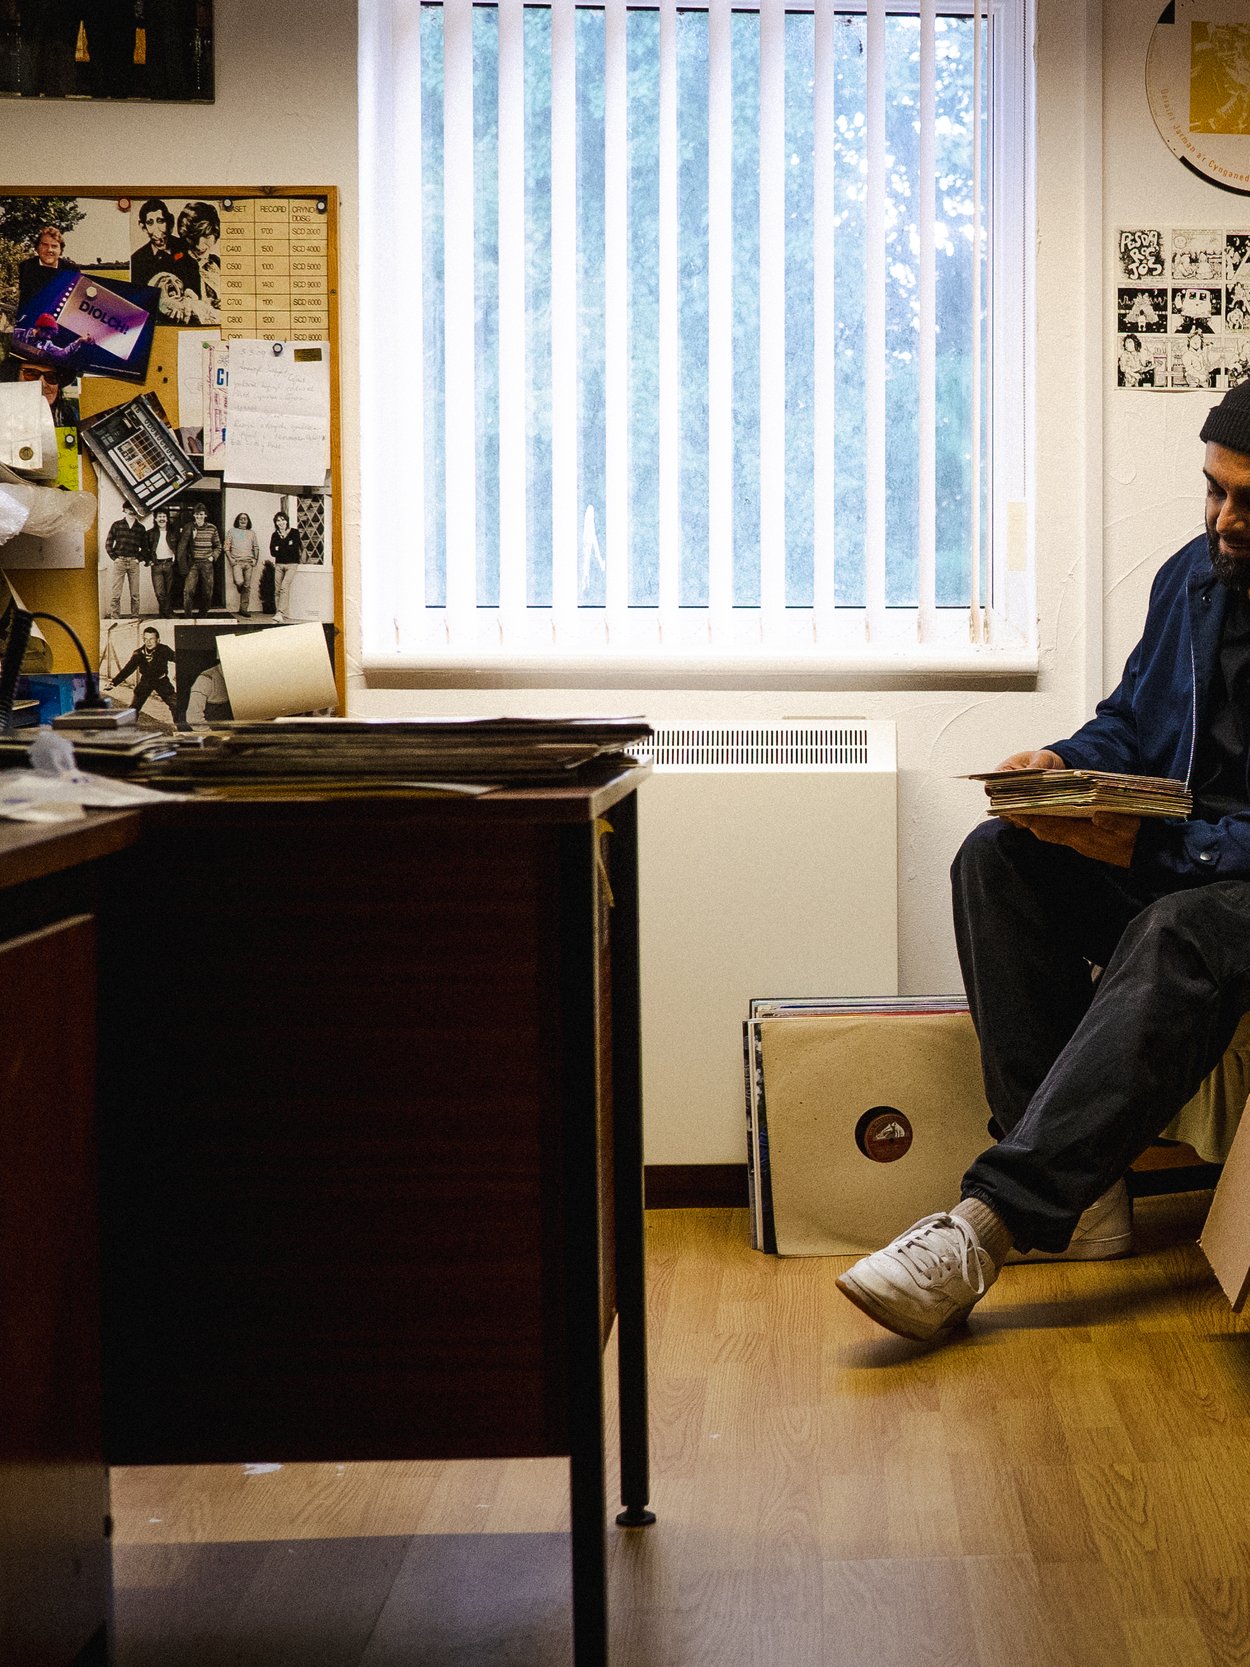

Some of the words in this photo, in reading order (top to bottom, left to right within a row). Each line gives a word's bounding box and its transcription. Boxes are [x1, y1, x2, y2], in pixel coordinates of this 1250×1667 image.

[1173, 124, 1196, 152] Jarman
[260, 205, 287, 213] RECORD
[78, 300, 130, 335] DIOLCH!
